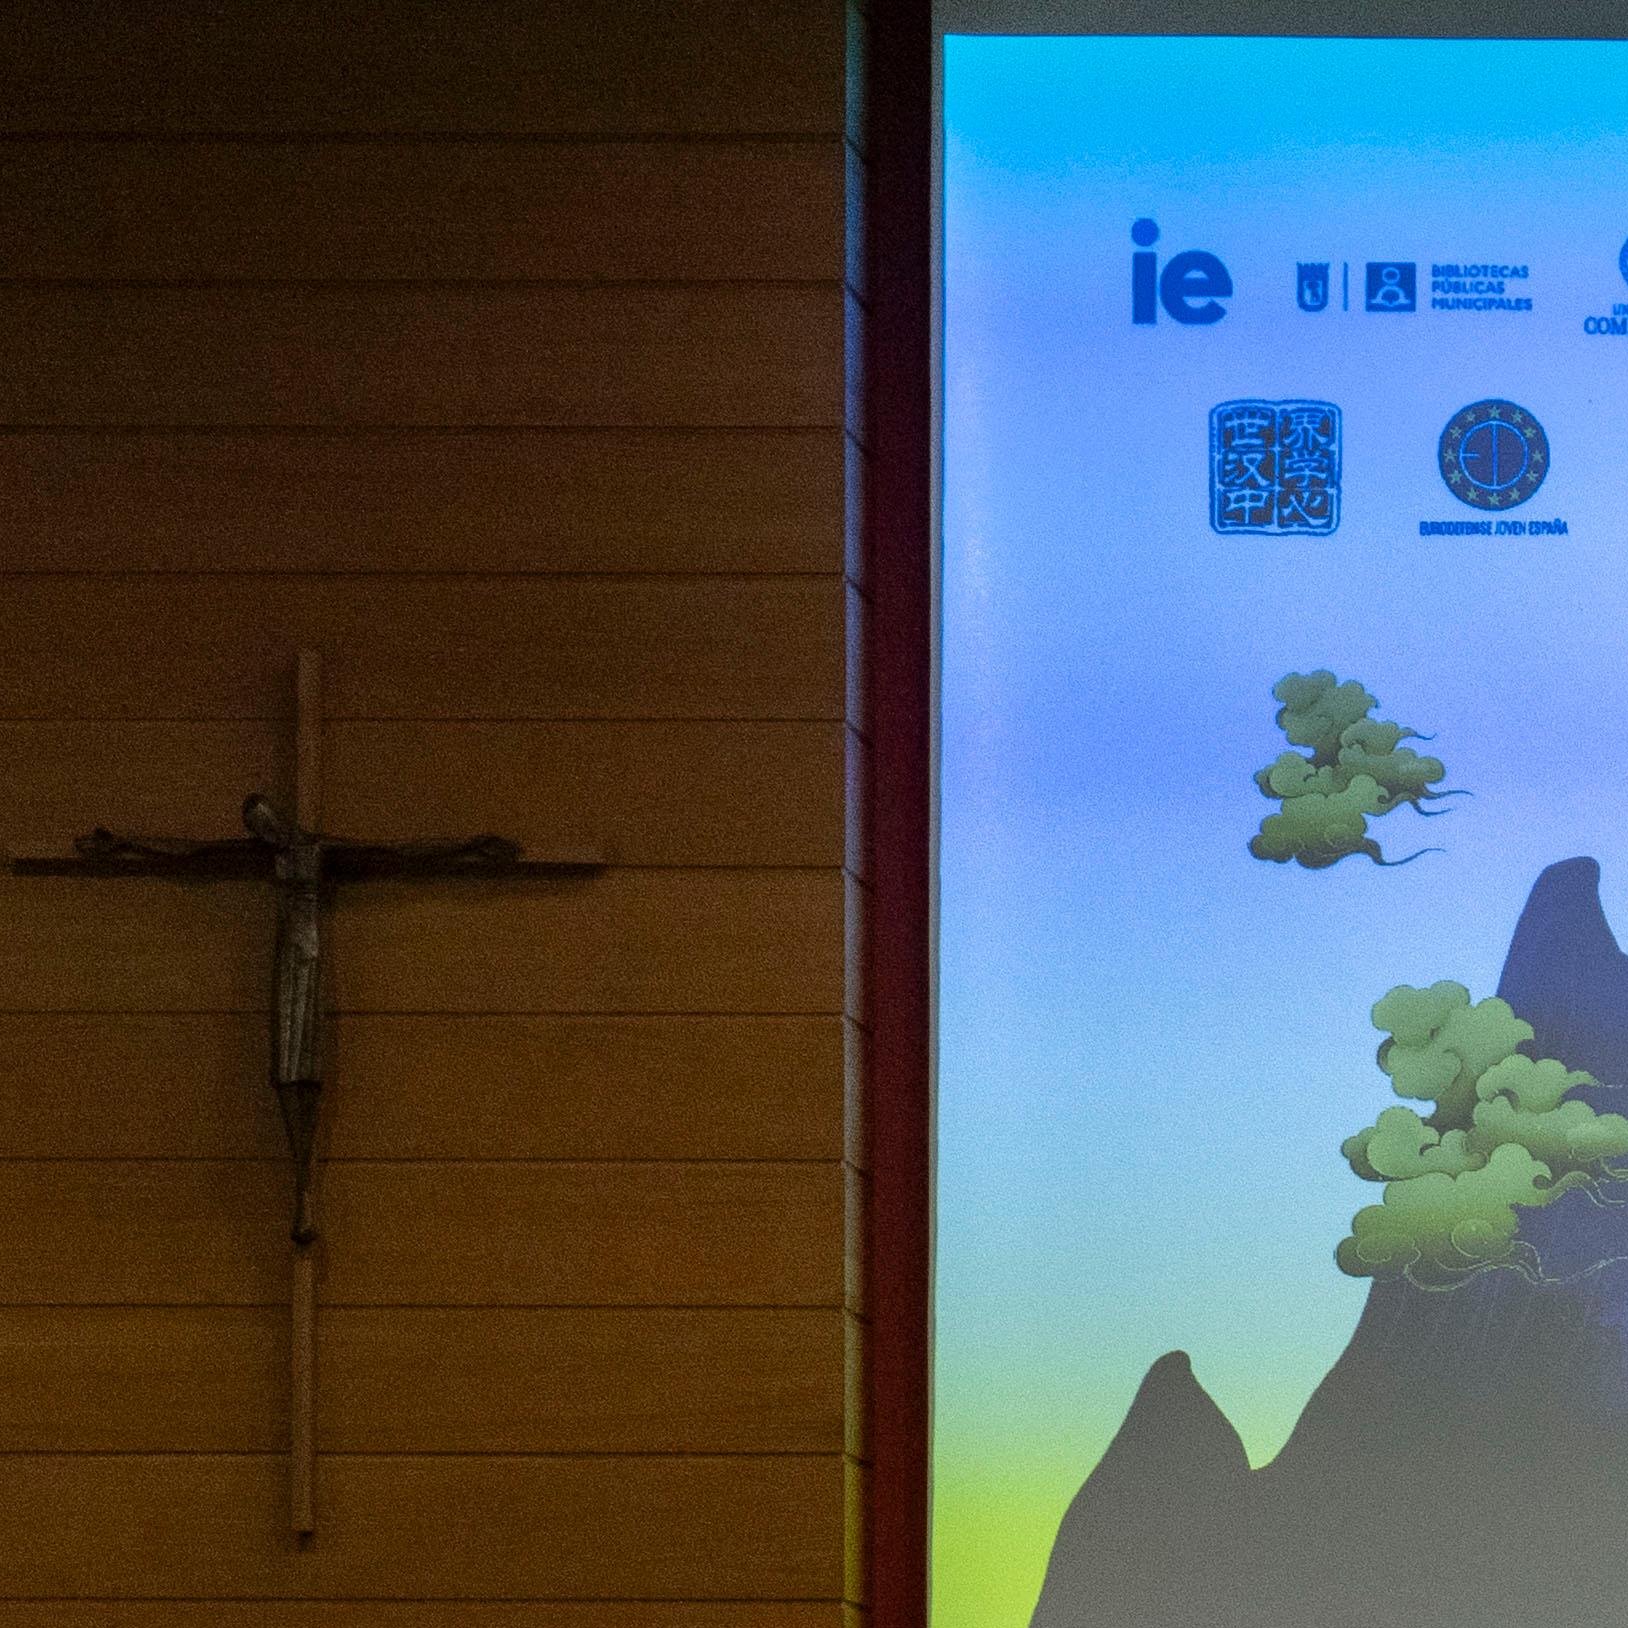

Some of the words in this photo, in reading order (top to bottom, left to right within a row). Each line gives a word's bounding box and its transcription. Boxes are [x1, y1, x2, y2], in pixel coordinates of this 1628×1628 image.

[1131, 217, 1234, 326] ie
[1431, 264, 1530, 280] BIBLIOTECAS
[1431, 278, 1505, 296] PÚBLICAS
[1431, 297, 1533, 312] MUNICIPALES
[1494, 520, 1526, 536] JOVEN
[1528, 517, 1568, 536] ESPAÑA
